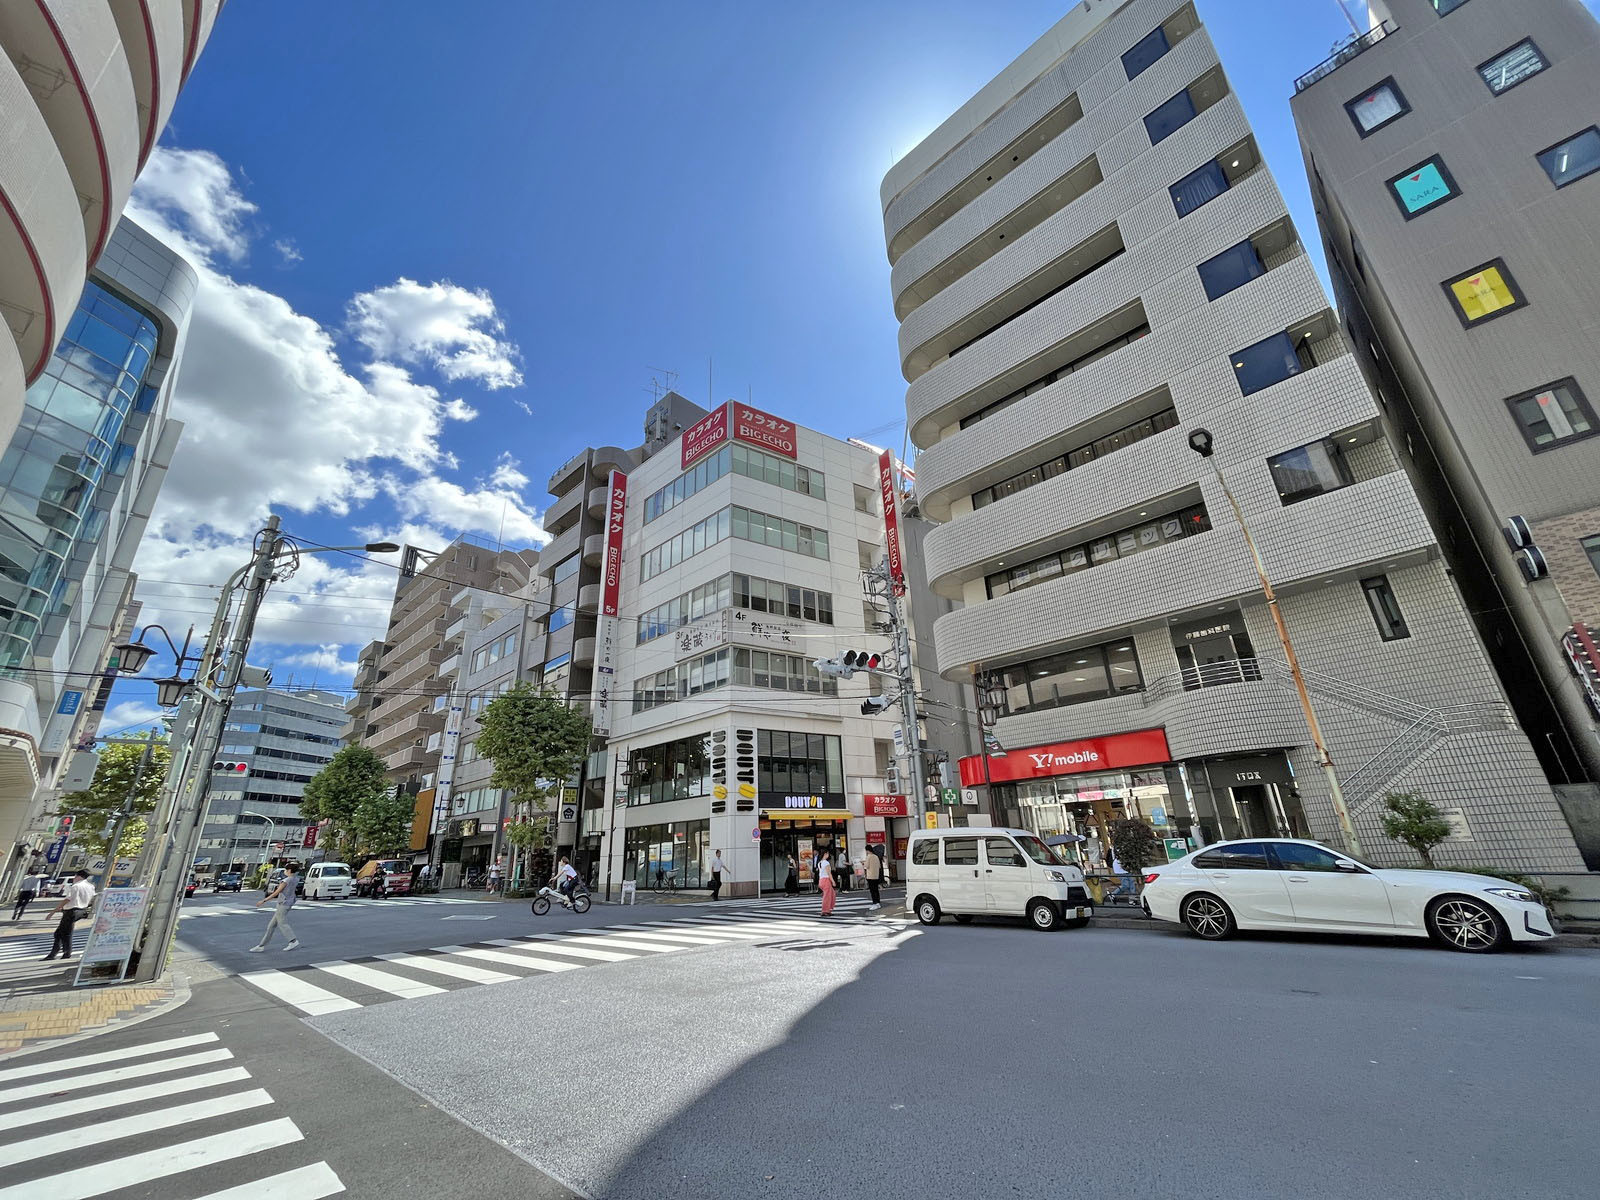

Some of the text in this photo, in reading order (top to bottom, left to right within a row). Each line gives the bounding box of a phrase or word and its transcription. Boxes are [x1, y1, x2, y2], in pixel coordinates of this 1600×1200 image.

[687, 411, 723, 444] カラオケ
[741, 410, 790, 433] カラオケ
[685, 444, 700, 461] BIG
[701, 427, 724, 447] ECHO
[740, 425, 761, 439] BIG
[763, 434, 793, 452] ECHO
[882, 467, 894, 516] カラオケ
[610, 488, 625, 533] カラオケ
[607, 547, 618, 586] BIG ECHO
[605, 605, 616, 614] 5F
[735, 611, 747, 621] 4F
[784, 795, 823, 808] DOUTOR
[874, 796, 896, 804] カラオケ
